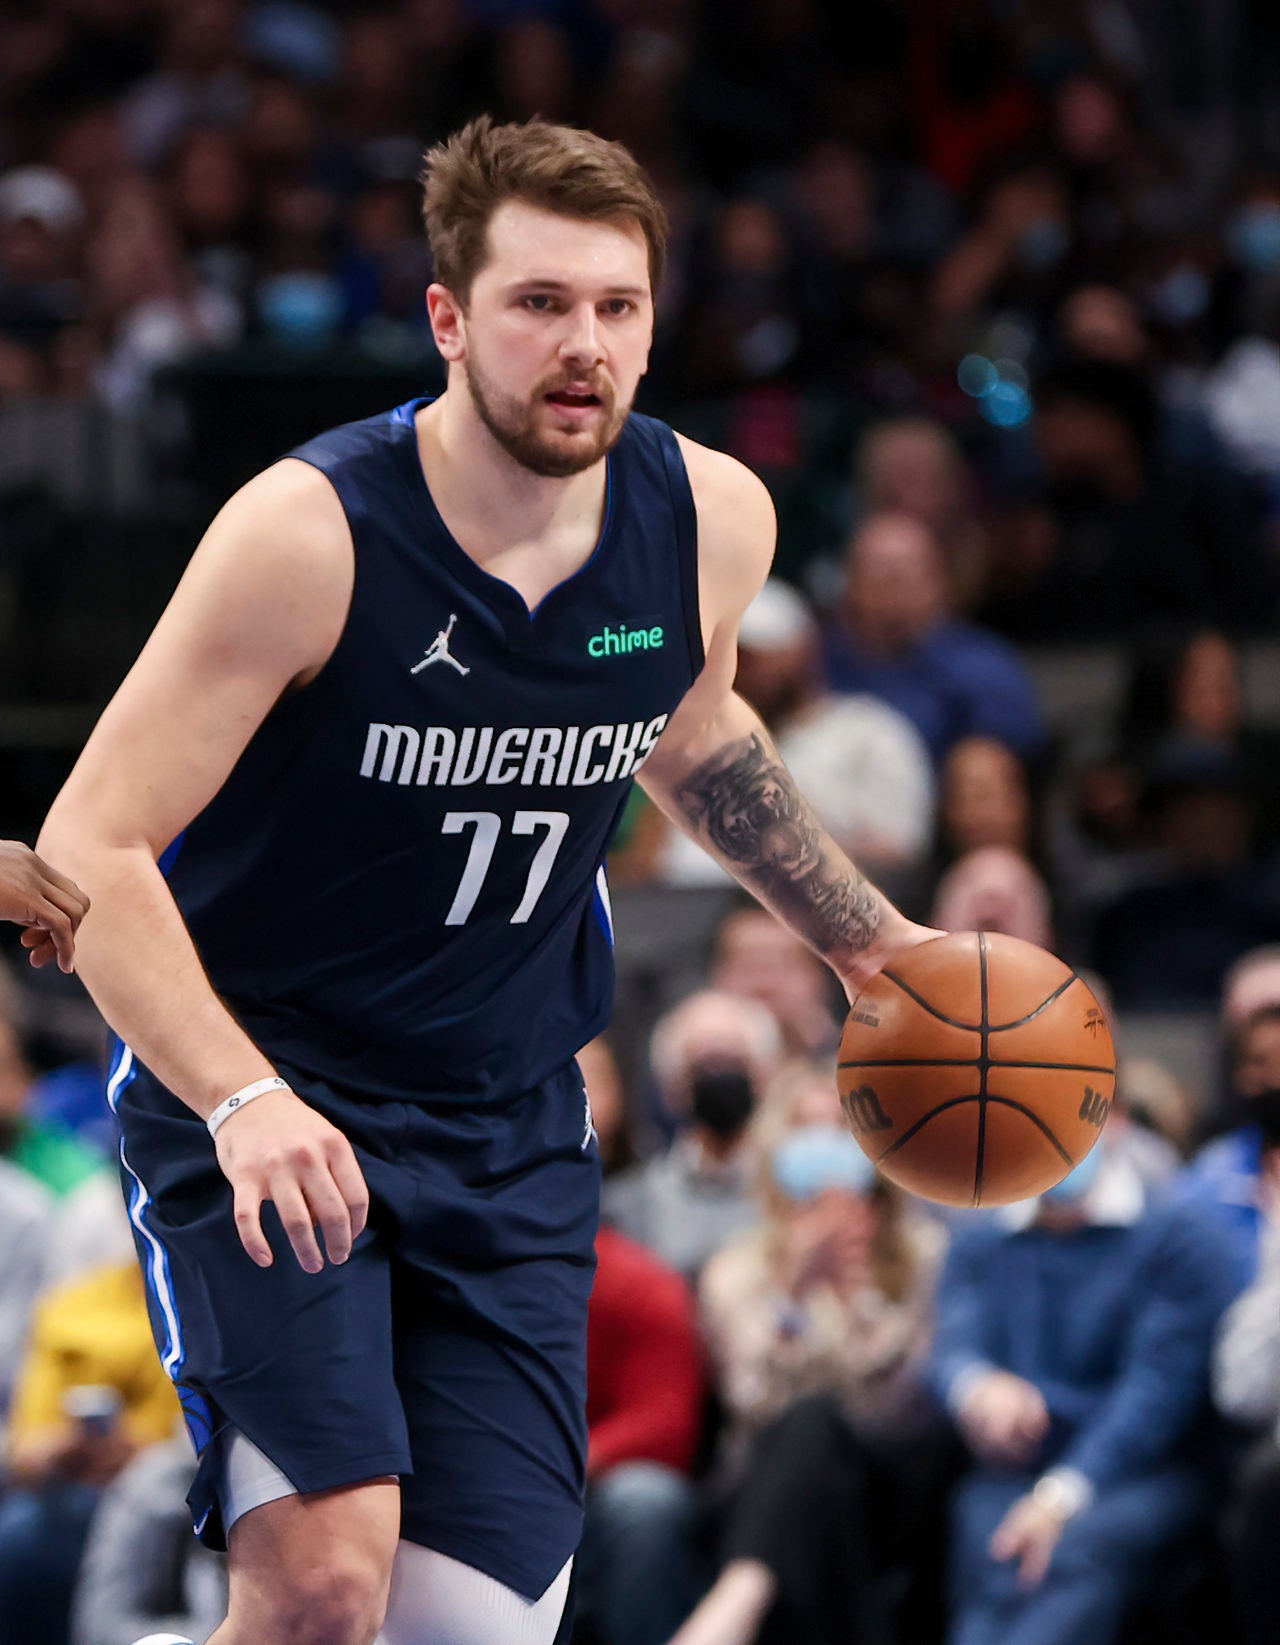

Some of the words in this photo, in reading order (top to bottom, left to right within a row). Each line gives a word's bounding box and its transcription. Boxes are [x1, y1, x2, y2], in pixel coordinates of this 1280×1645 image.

[588, 625, 664, 657] chime
[360, 713, 668, 787] MAVERICKS
[441, 810, 570, 926] 77
